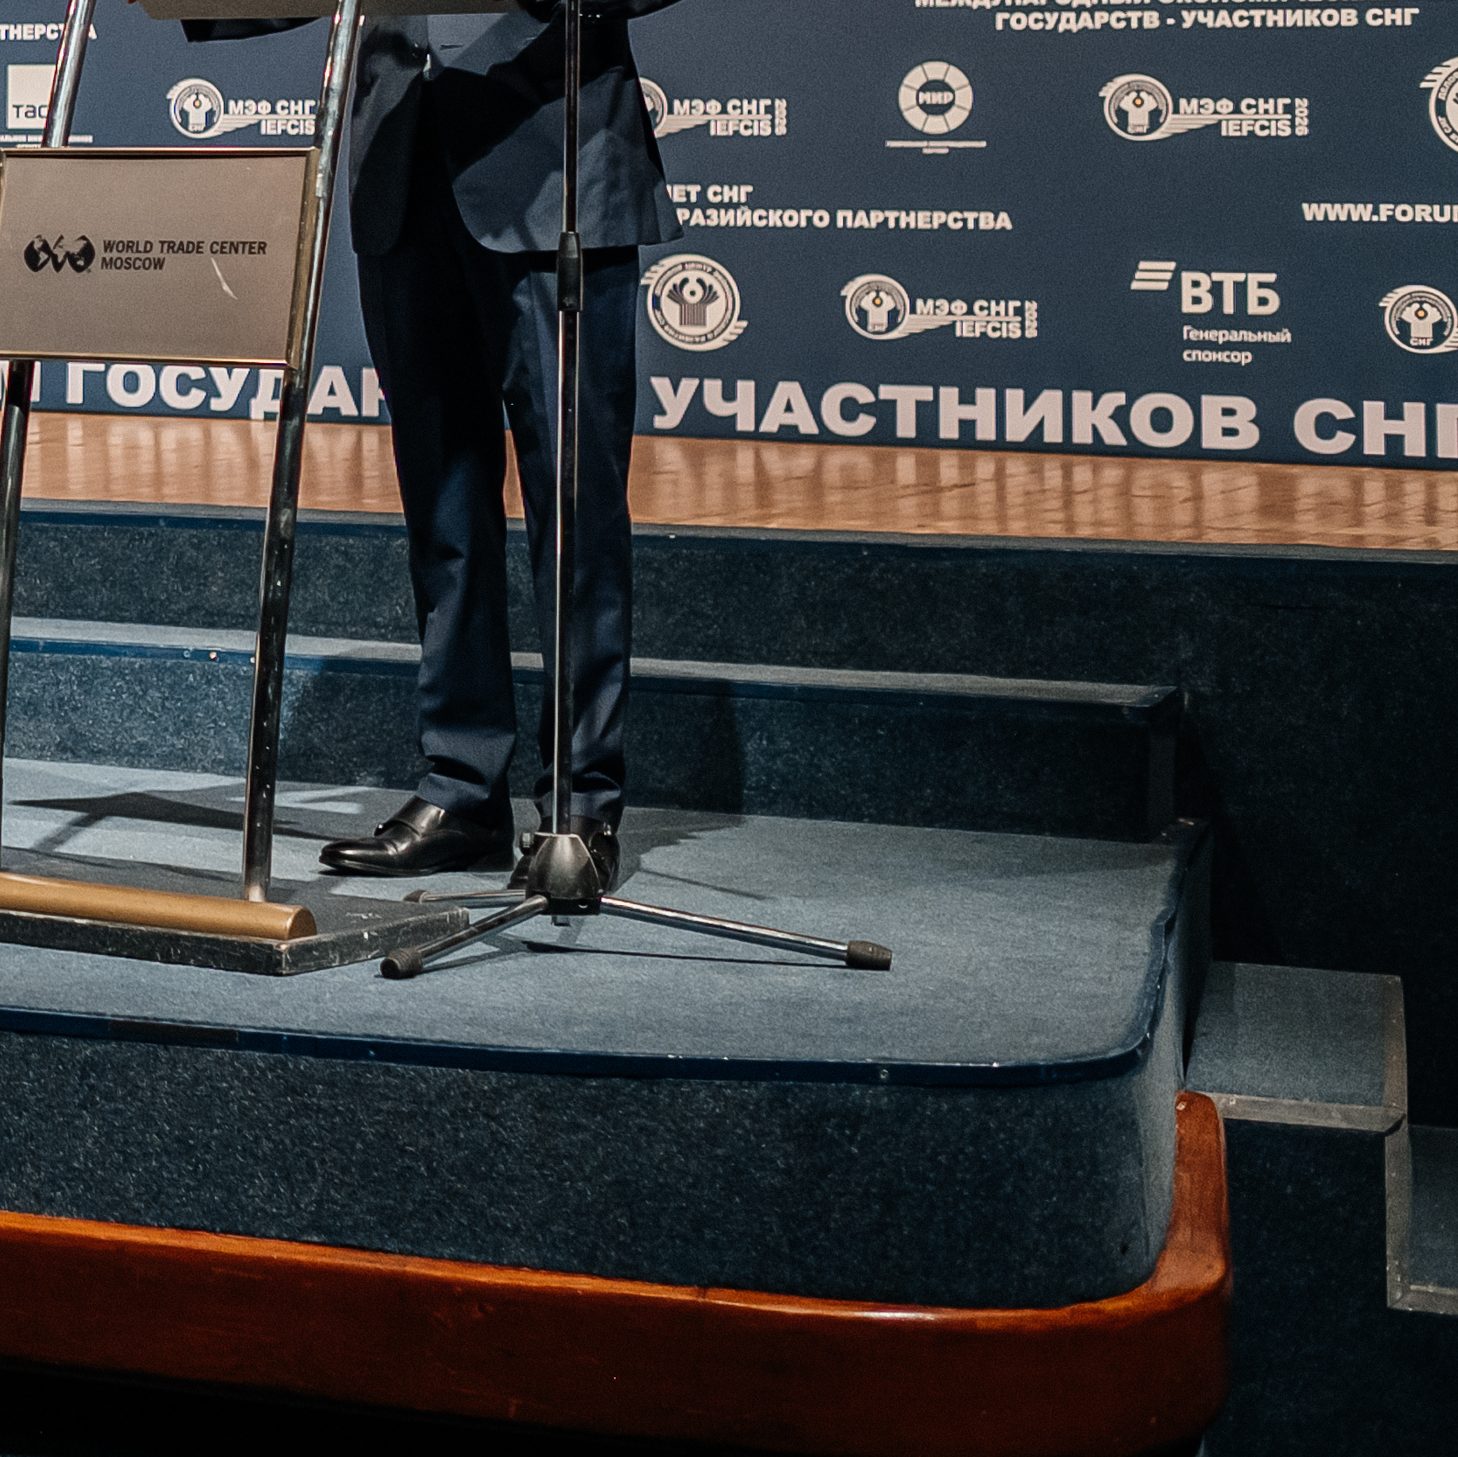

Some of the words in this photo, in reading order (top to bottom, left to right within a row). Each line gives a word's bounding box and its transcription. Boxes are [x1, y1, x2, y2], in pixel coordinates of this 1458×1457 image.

[995, 11, 1160, 32] ГОСУДАРСТВ
[1181, 9, 1359, 28] УЧАСТНИКОВ
[1365, 8, 1420, 26] СНГ
[228, 100, 272, 115] МЭФ
[276, 99, 315, 115] СНГ
[673, 98, 722, 114] МЭФ
[726, 98, 773, 114] СНГ
[1179, 97, 1233, 115] МЭФ
[1240, 97, 1292, 115] СНГ
[261, 119, 315, 135] IEFCIS
[709, 119, 773, 136] IEFCIS
[1221, 119, 1292, 137] IEFCIS
[707, 185, 753, 203] СНГ
[676, 206, 830, 228] РАЗИЙСКОГО
[836, 210, 1013, 231] ПАРТНЕРСТВА
[1302, 203, 1458, 222] WWW.FORU
[103, 240, 154, 254] WORLD
[158, 240, 205, 254] TRADE
[210, 241, 268, 254] CENTER
[101, 256, 166, 271] MOSCOW
[1181, 271, 1281, 315] ВТБ
[916, 298, 969, 316] МЭФ
[972, 299, 1022, 317] СНГ
[955, 320, 1022, 339] IEFCIS
[1183, 325, 1291, 344] Генеральный
[1183, 349, 1252, 366] спонсор
[650, 376, 1260, 450] УЧАСТНИКОВ
